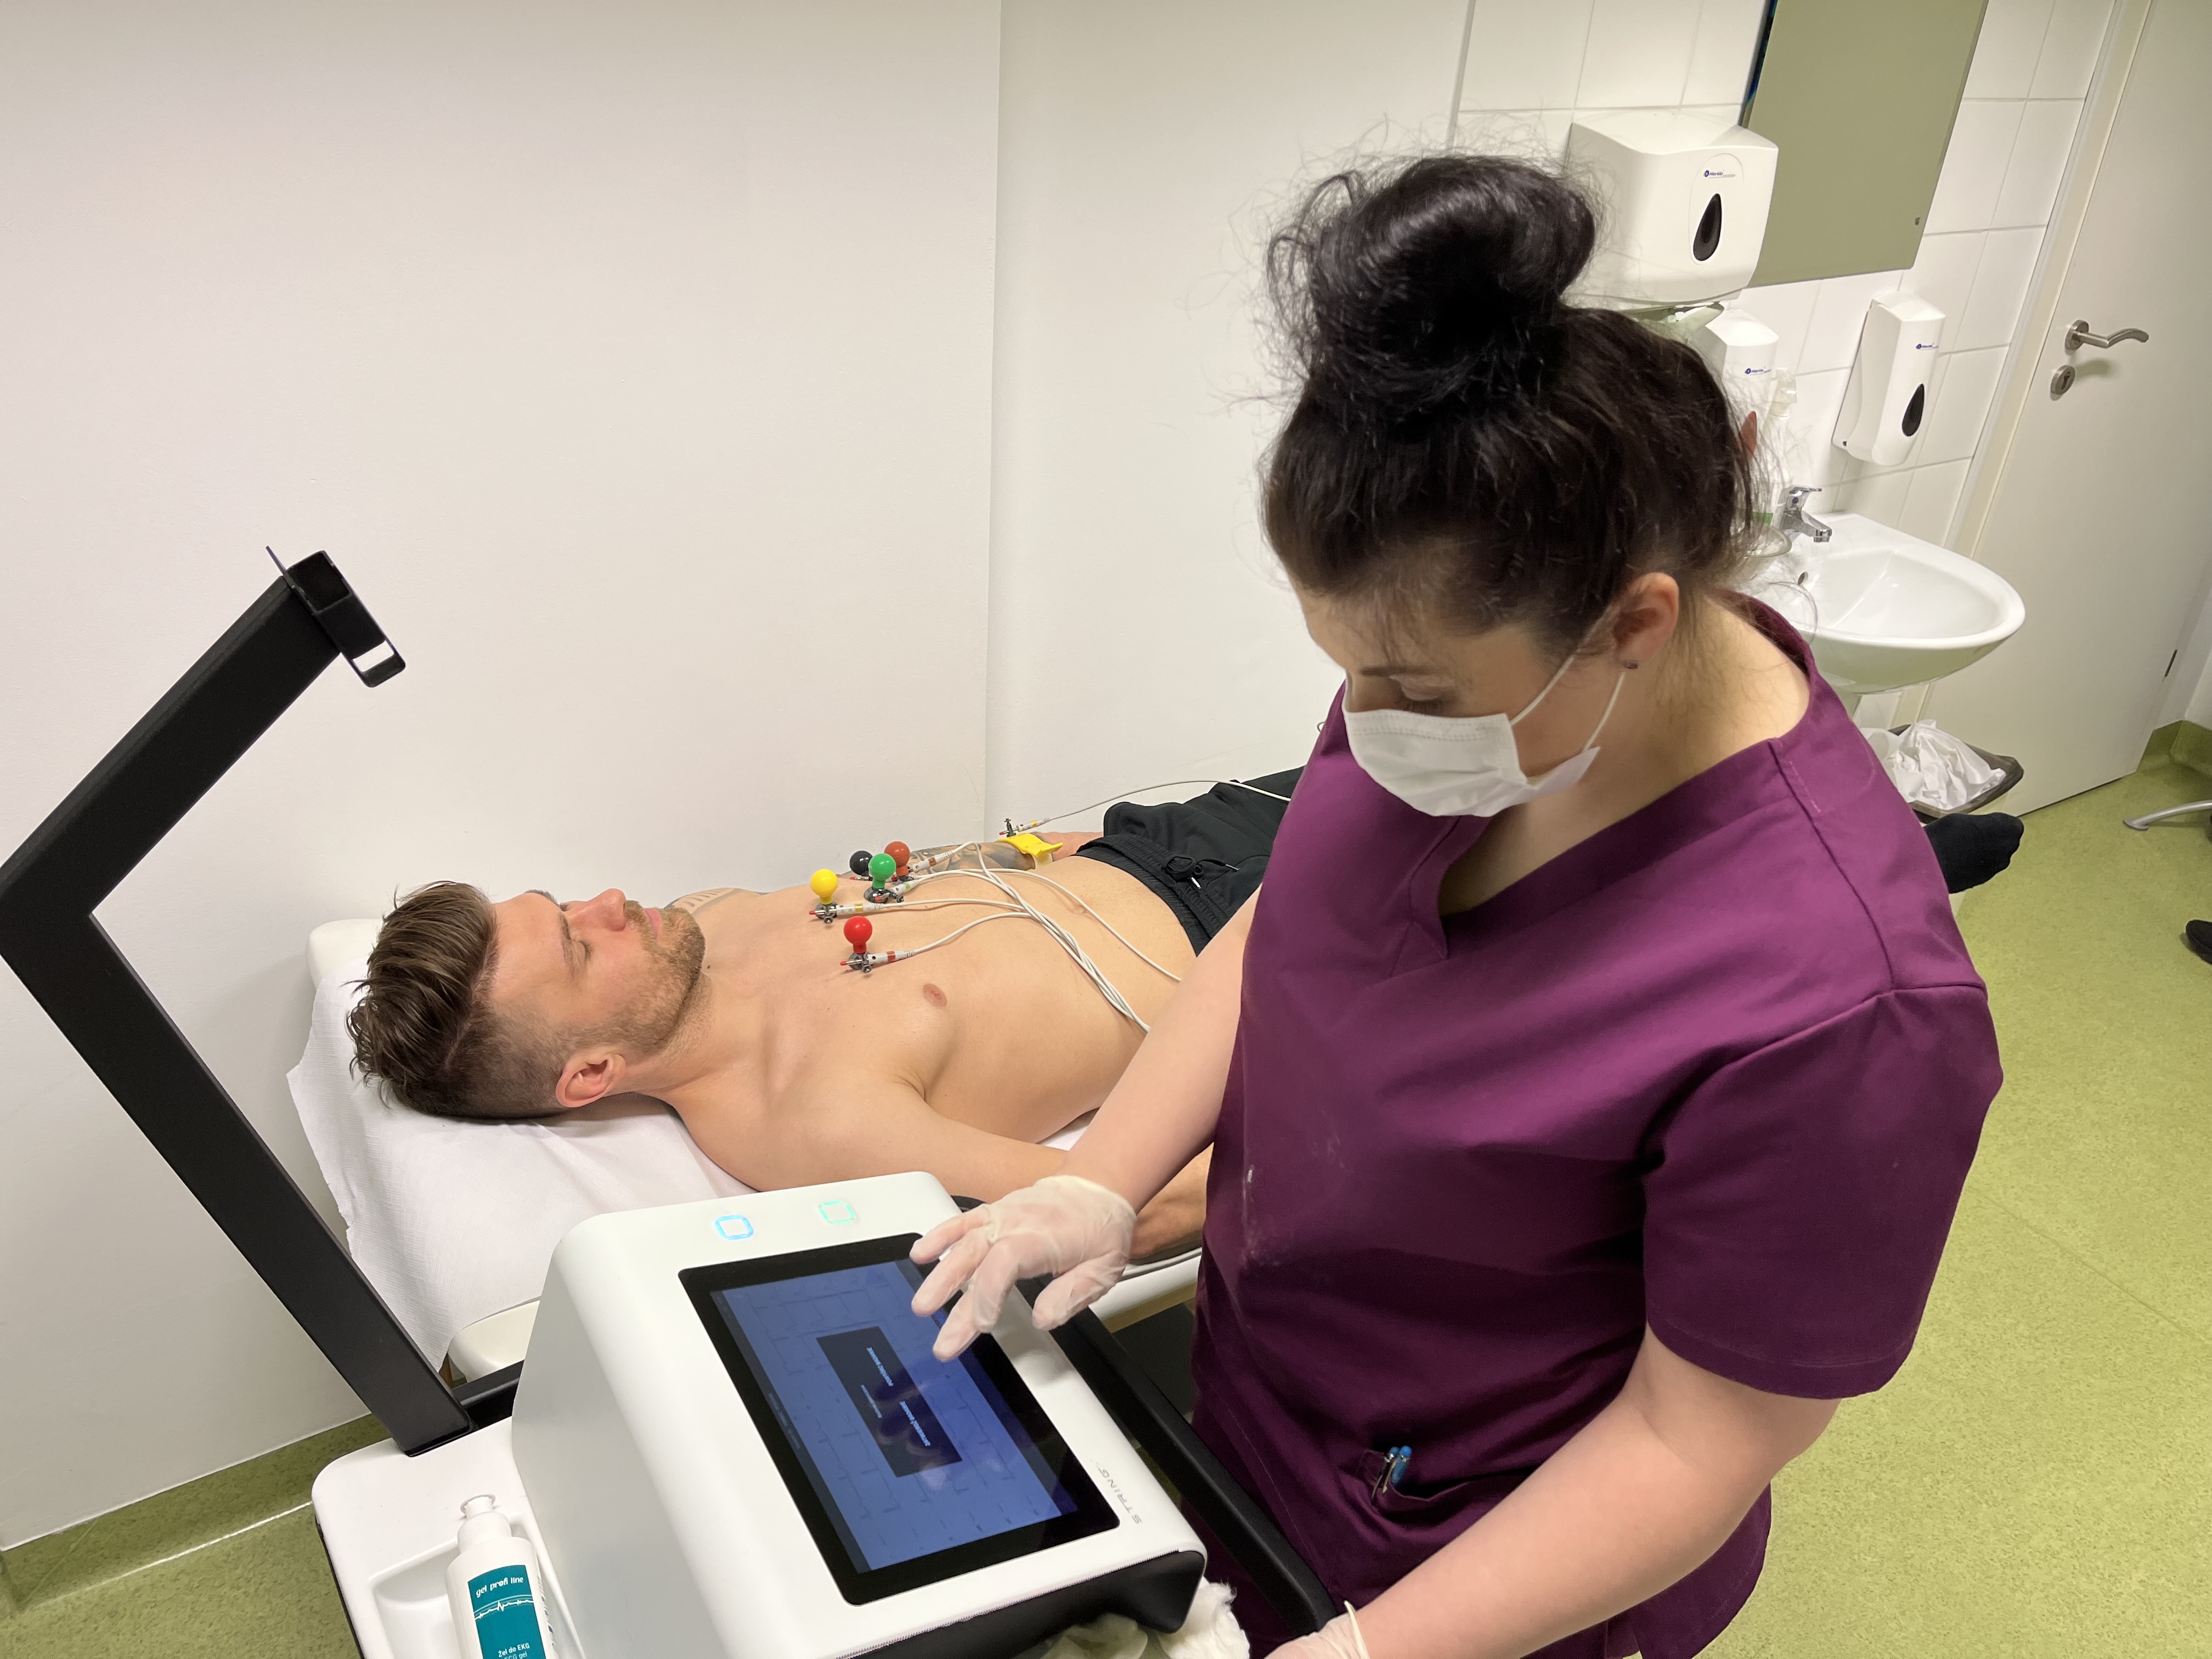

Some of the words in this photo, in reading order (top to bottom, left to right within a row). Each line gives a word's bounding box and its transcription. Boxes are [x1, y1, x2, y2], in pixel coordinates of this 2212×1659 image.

[1097, 1467, 1142, 1524] STRING
[476, 1585, 487, 1598] gel
[490, 1577, 508, 1591] profi
[517, 1643, 530, 1651] EKG
[518, 1651, 528, 1659] gel
